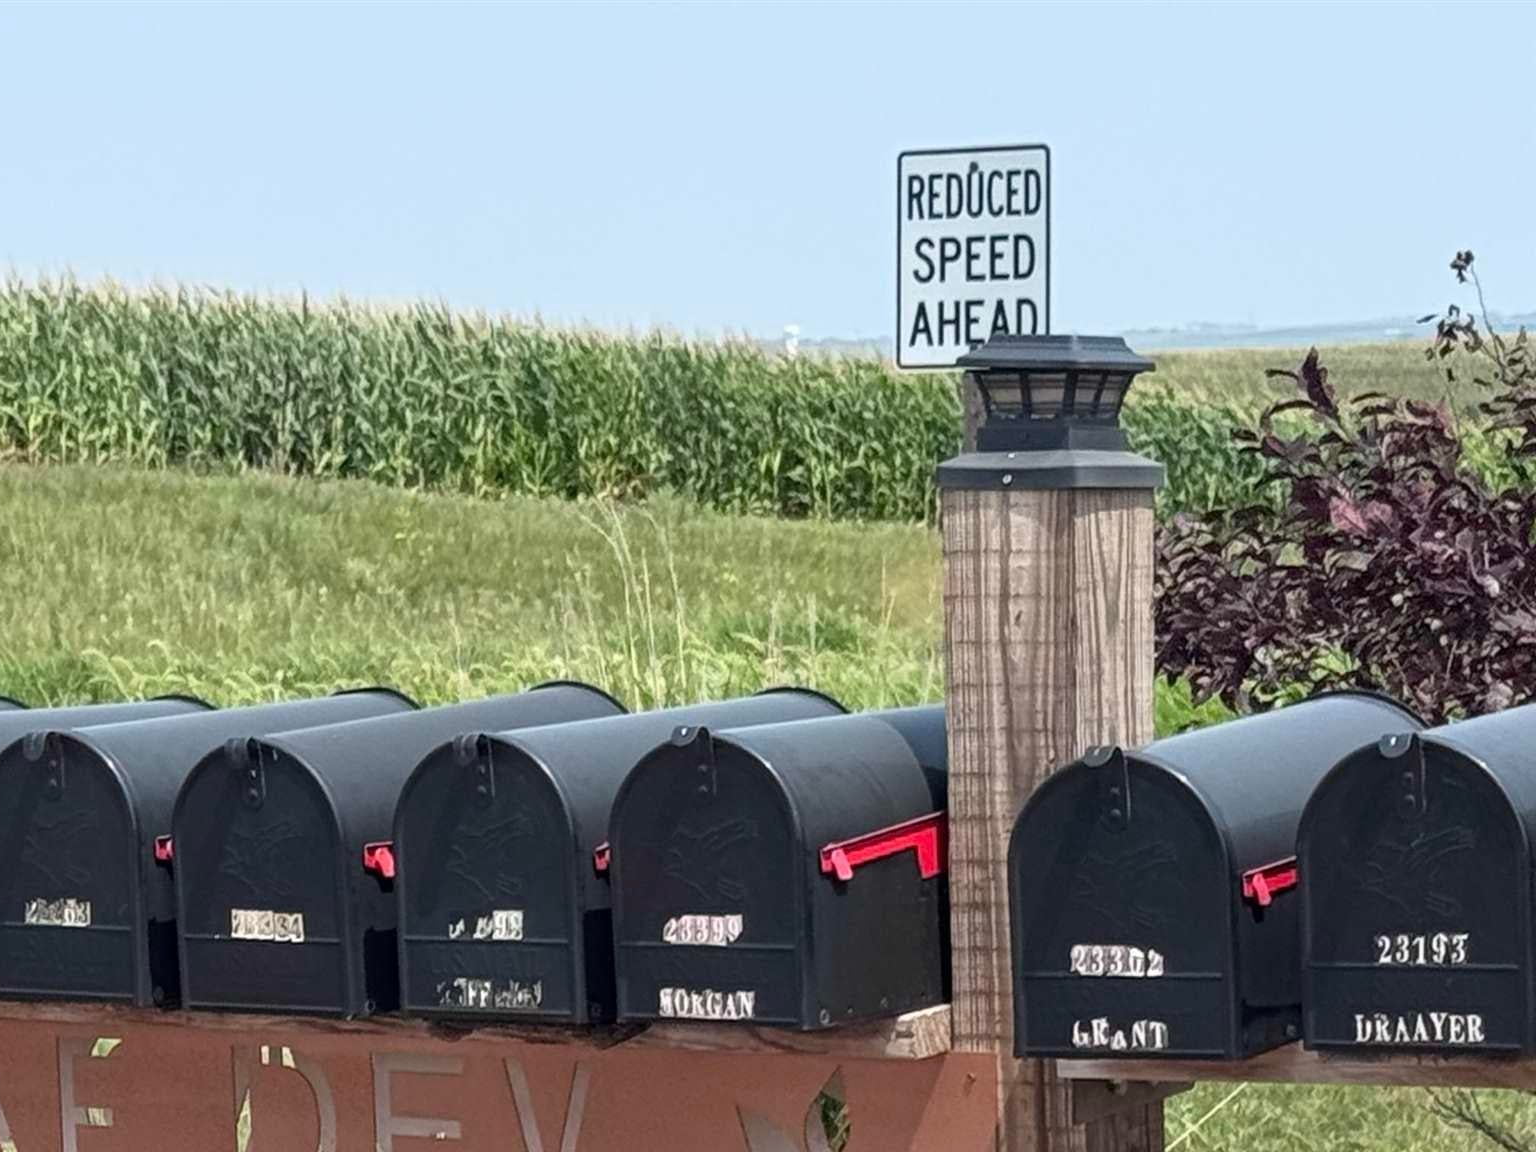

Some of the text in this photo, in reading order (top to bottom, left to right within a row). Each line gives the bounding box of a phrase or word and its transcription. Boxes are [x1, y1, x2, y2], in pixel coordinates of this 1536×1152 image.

[907, 168, 1042, 221] REDUCED
[913, 233, 1035, 283] SPEED
[909, 297, 1038, 347] AHEAD
[662, 914, 743, 946] 23399
[1376, 932, 1470, 965] 23193
[1354, 1011, 1486, 1045] DRAAYER
